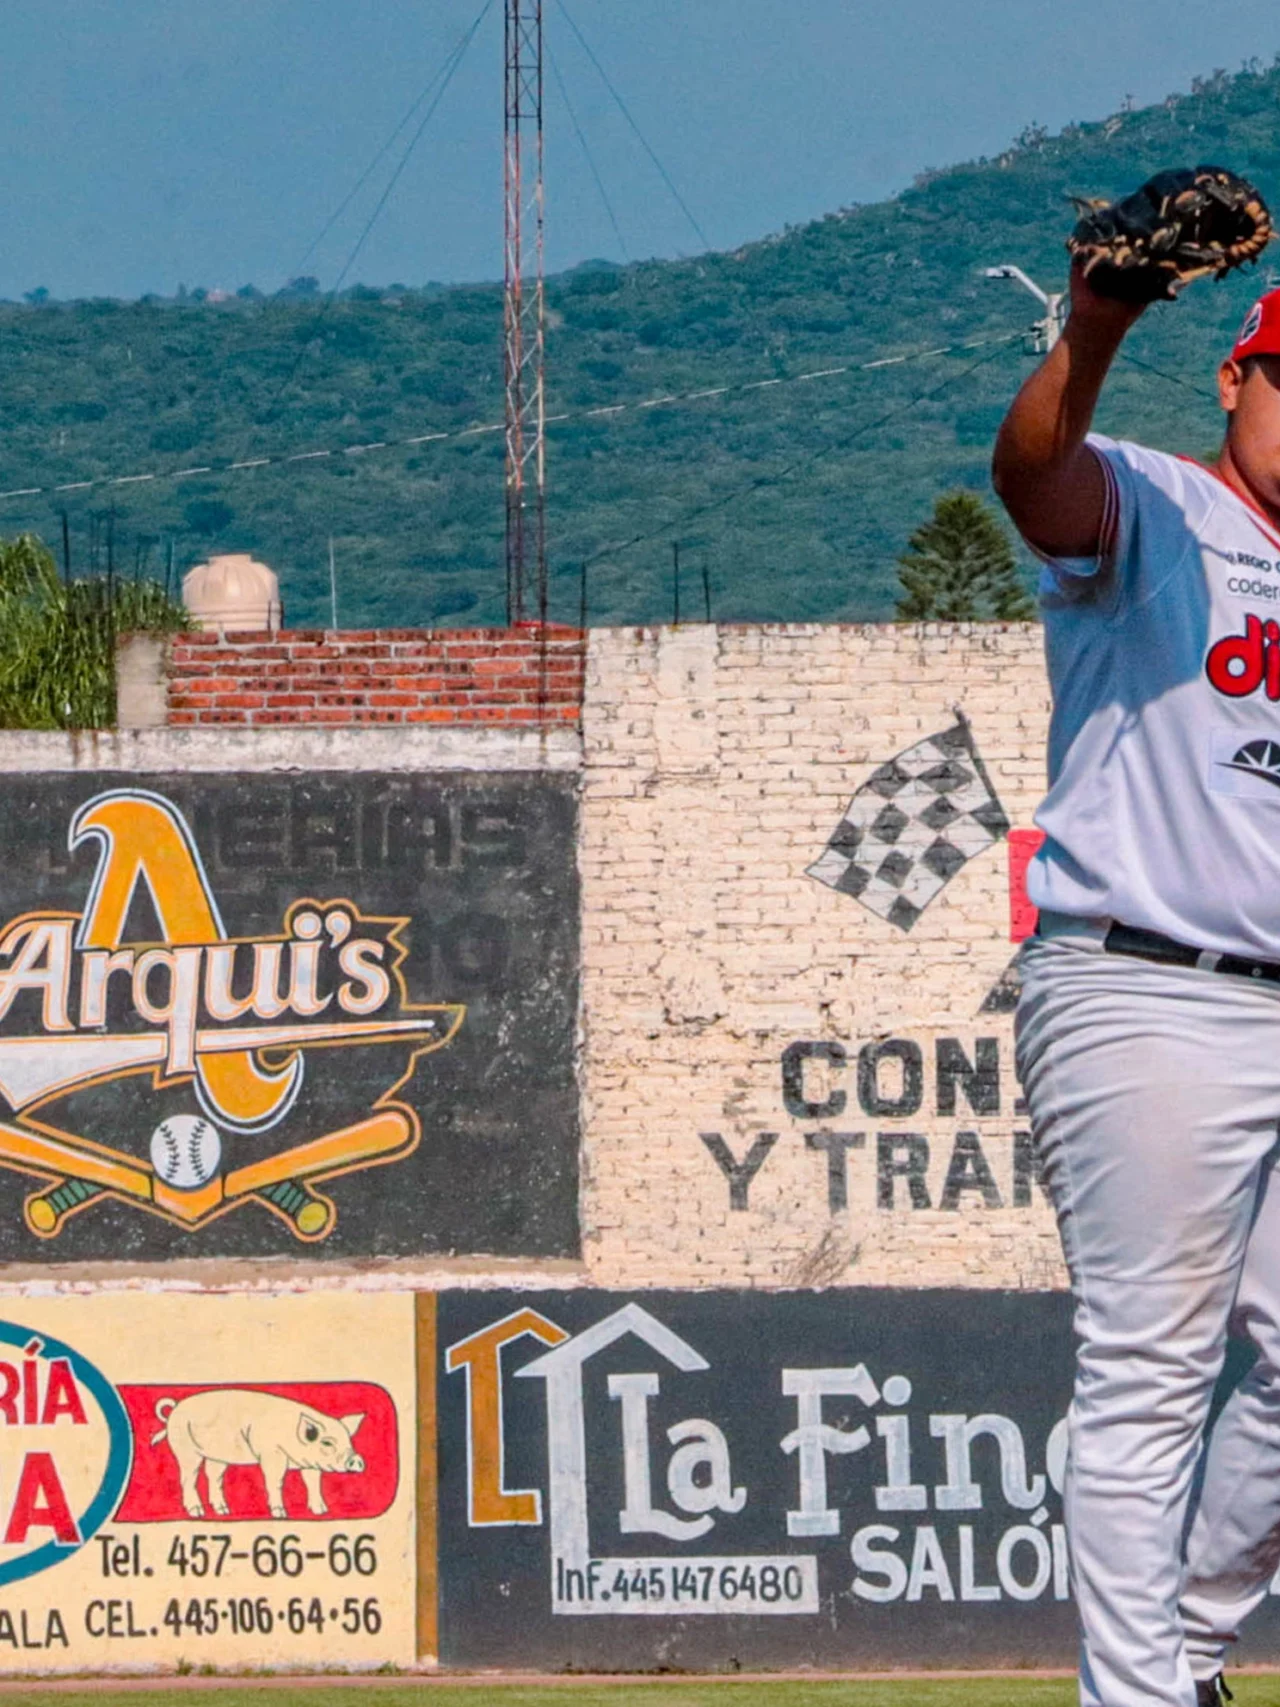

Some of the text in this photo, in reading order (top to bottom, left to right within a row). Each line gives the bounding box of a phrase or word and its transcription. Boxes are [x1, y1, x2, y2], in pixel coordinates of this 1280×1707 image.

[701, 1132, 780, 1211] Y
[608, 1362, 1068, 1541] La Fin
[95, 1533, 377, 1577] Tel. 457-66-66
[85, 1600, 158, 1637] CEL.
